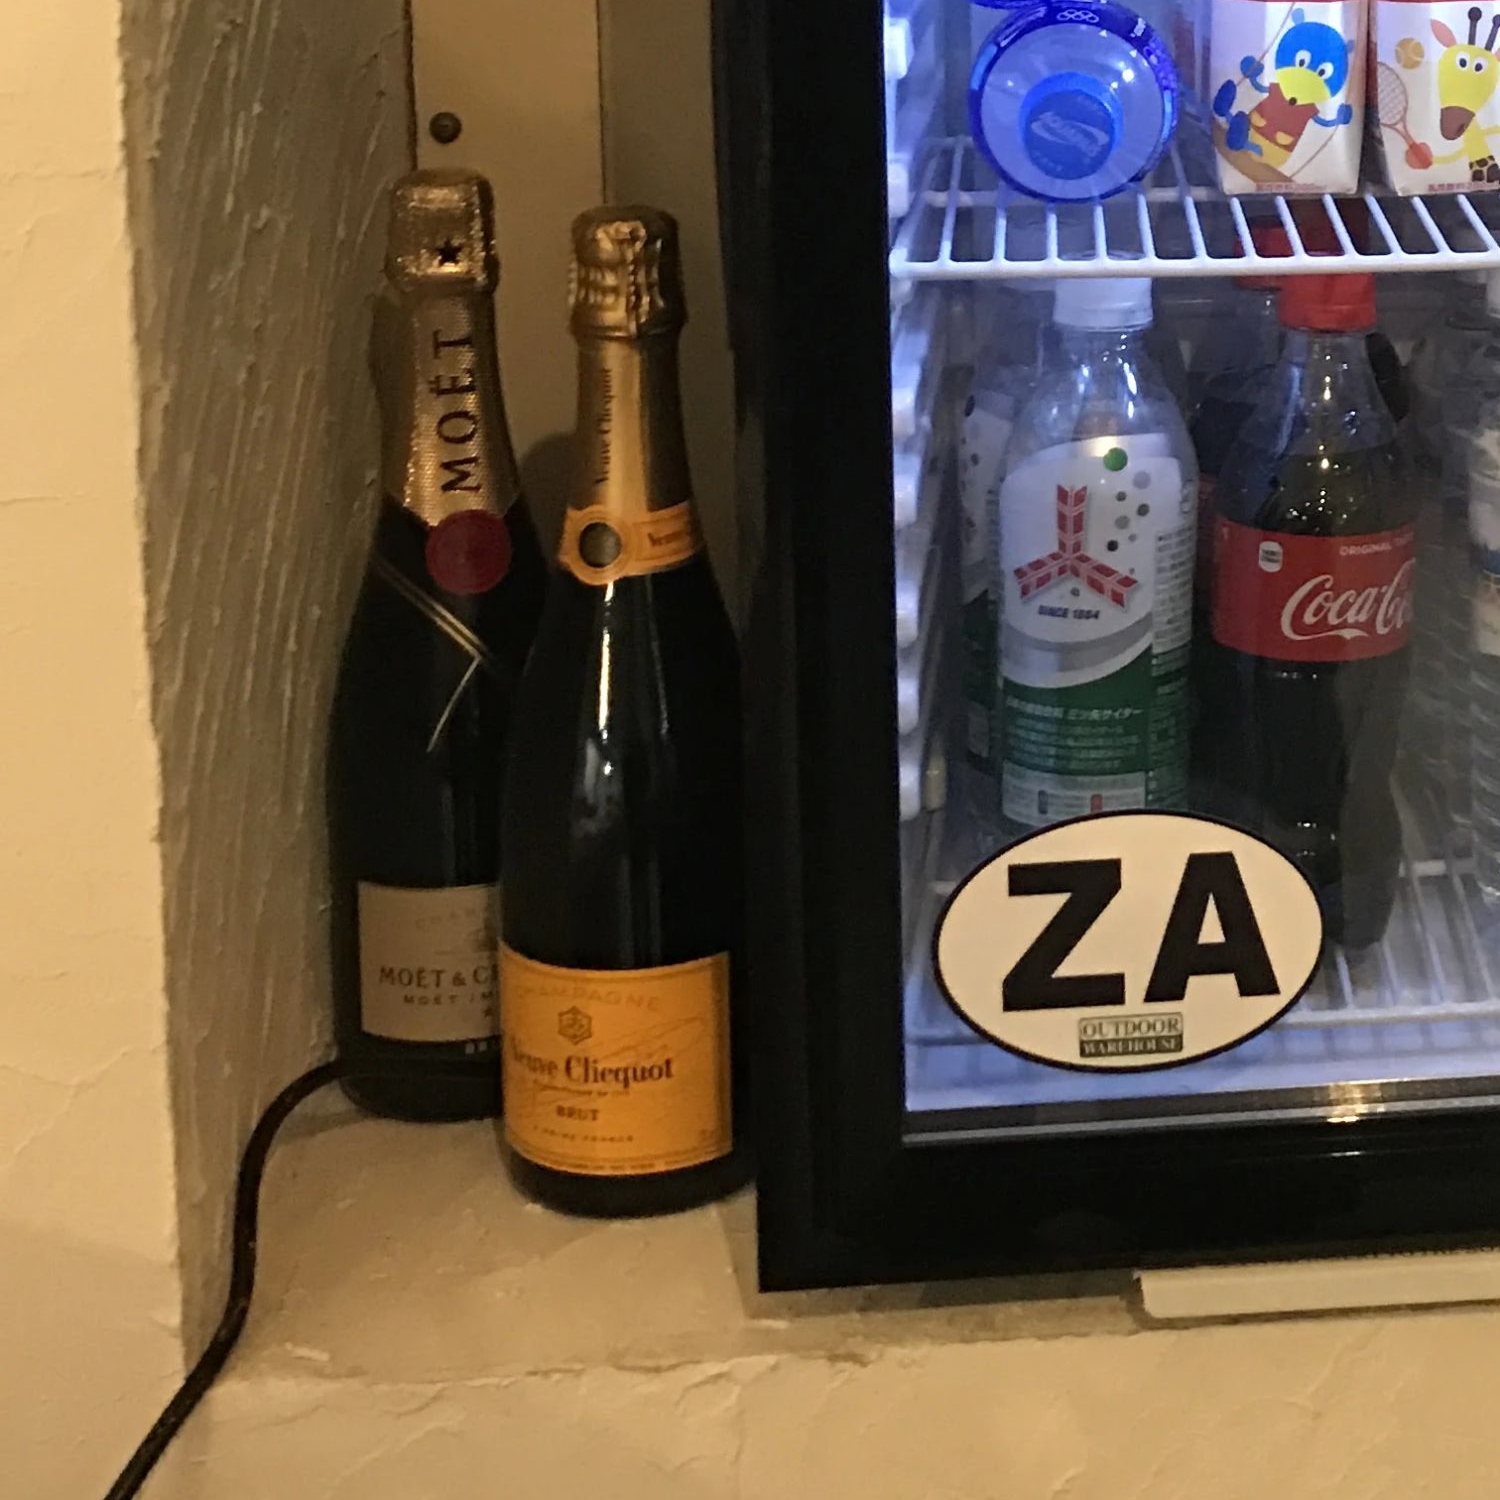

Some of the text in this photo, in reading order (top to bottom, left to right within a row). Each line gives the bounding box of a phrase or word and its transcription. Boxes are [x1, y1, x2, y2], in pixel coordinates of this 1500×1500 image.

[428, 328, 482, 495] MOËT
[1339, 541, 1392, 557] ORIGINAL
[1038, 604, 1069, 619] SINCE
[1001, 851, 1281, 1013] ZA
[1082, 1017, 1179, 1038] OUTDOOR
[1083, 1038, 1176, 1055] WAREHOUSE
[565, 1055, 674, 1090] Clicquot
[555, 1104, 601, 1122] BRUT
